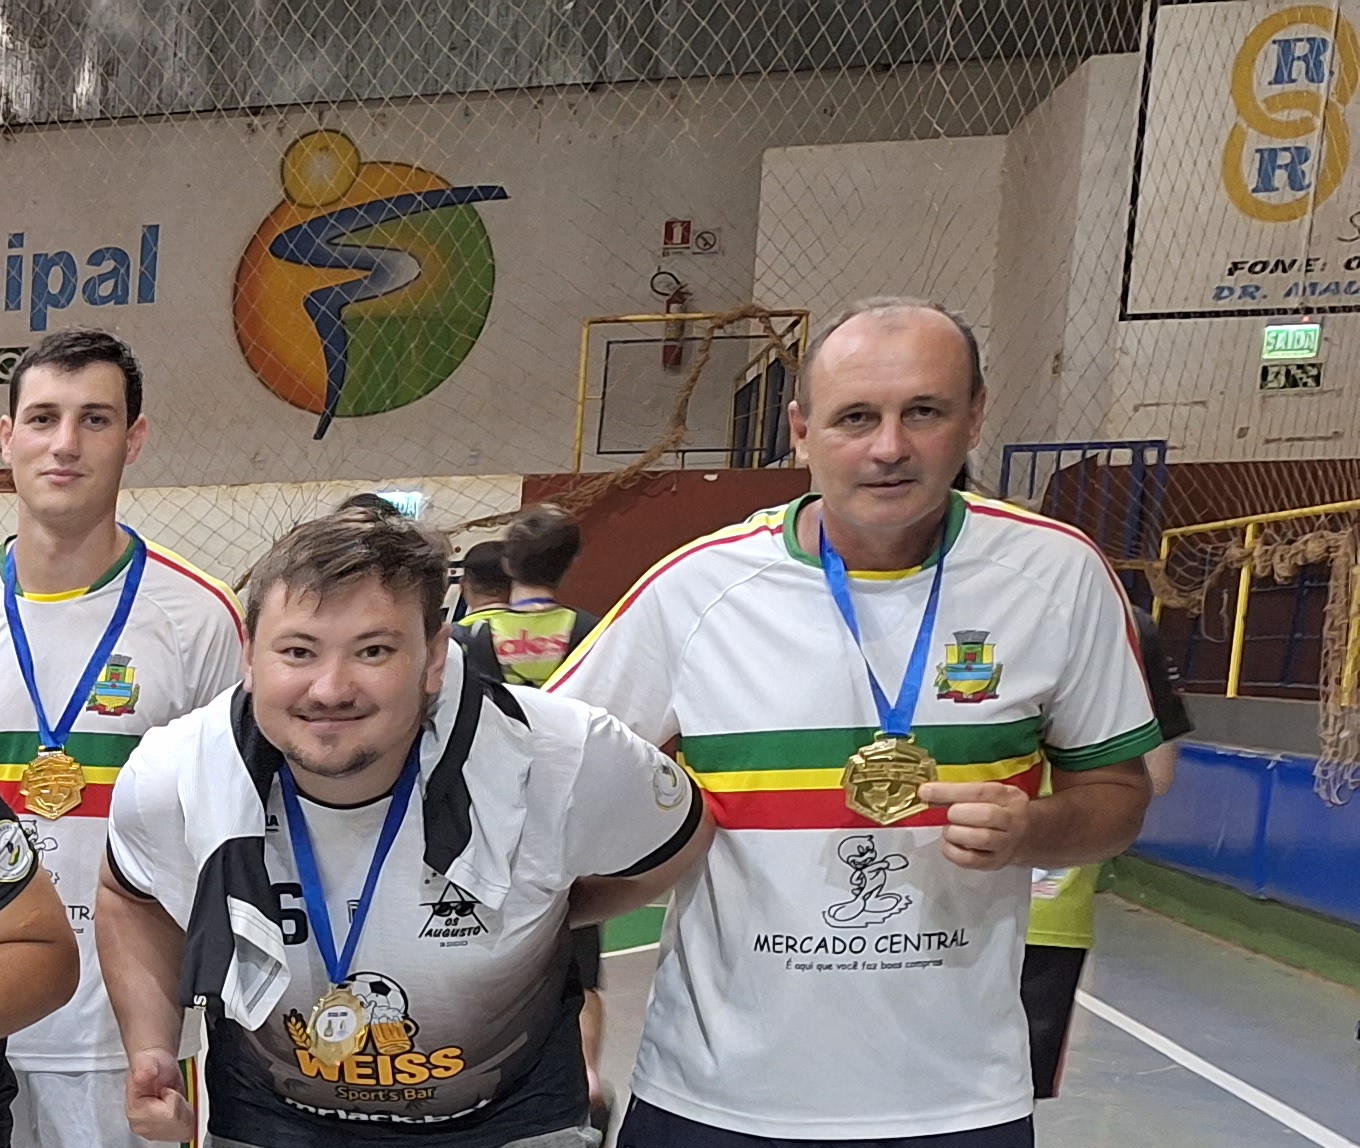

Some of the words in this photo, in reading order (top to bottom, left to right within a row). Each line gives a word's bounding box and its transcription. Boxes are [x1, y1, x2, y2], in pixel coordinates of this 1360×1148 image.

[444, 917, 460, 927] OS
[424, 925, 481, 938] AUGUSTO
[754, 934, 867, 955] MERCADO
[874, 928, 970, 954] CENTRAL
[795, 961, 813, 972] aqui
[817, 963, 833, 973] que
[836, 961, 859, 971] você
[862, 960, 878, 971] faz
[294, 1046, 466, 1087] WEISS
[336, 1086, 400, 1101] Sport's
[403, 1086, 437, 1101] Bar
